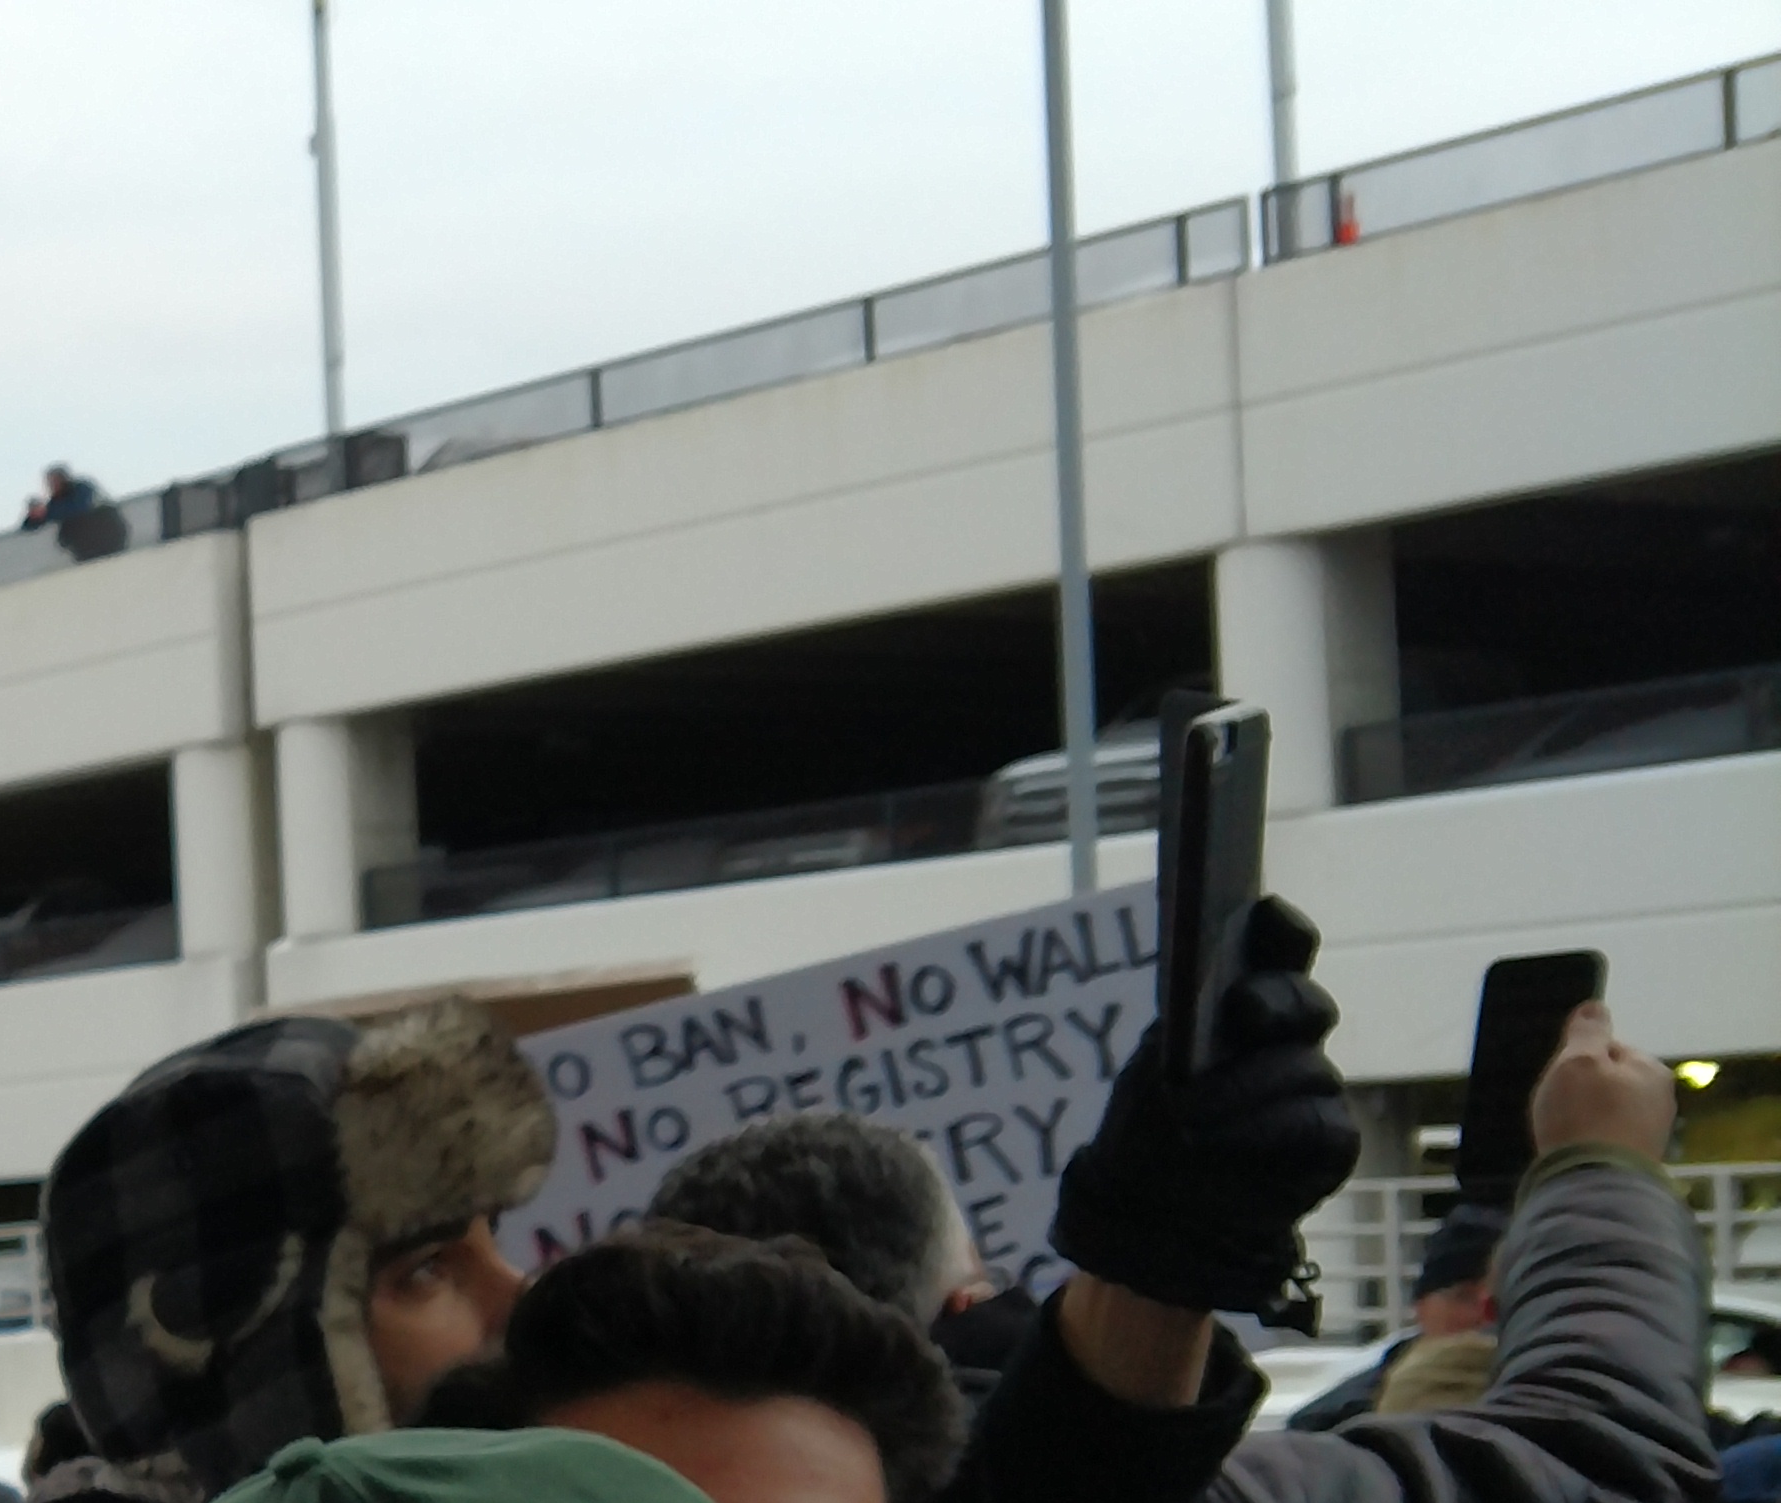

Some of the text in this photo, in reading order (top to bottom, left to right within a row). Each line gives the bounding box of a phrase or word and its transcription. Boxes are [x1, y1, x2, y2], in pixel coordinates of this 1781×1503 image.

[546, 1050, 592, 1101] O
[840, 961, 957, 1042] NO
[579, 1002, 1123, 1184] NO REGISTRY
